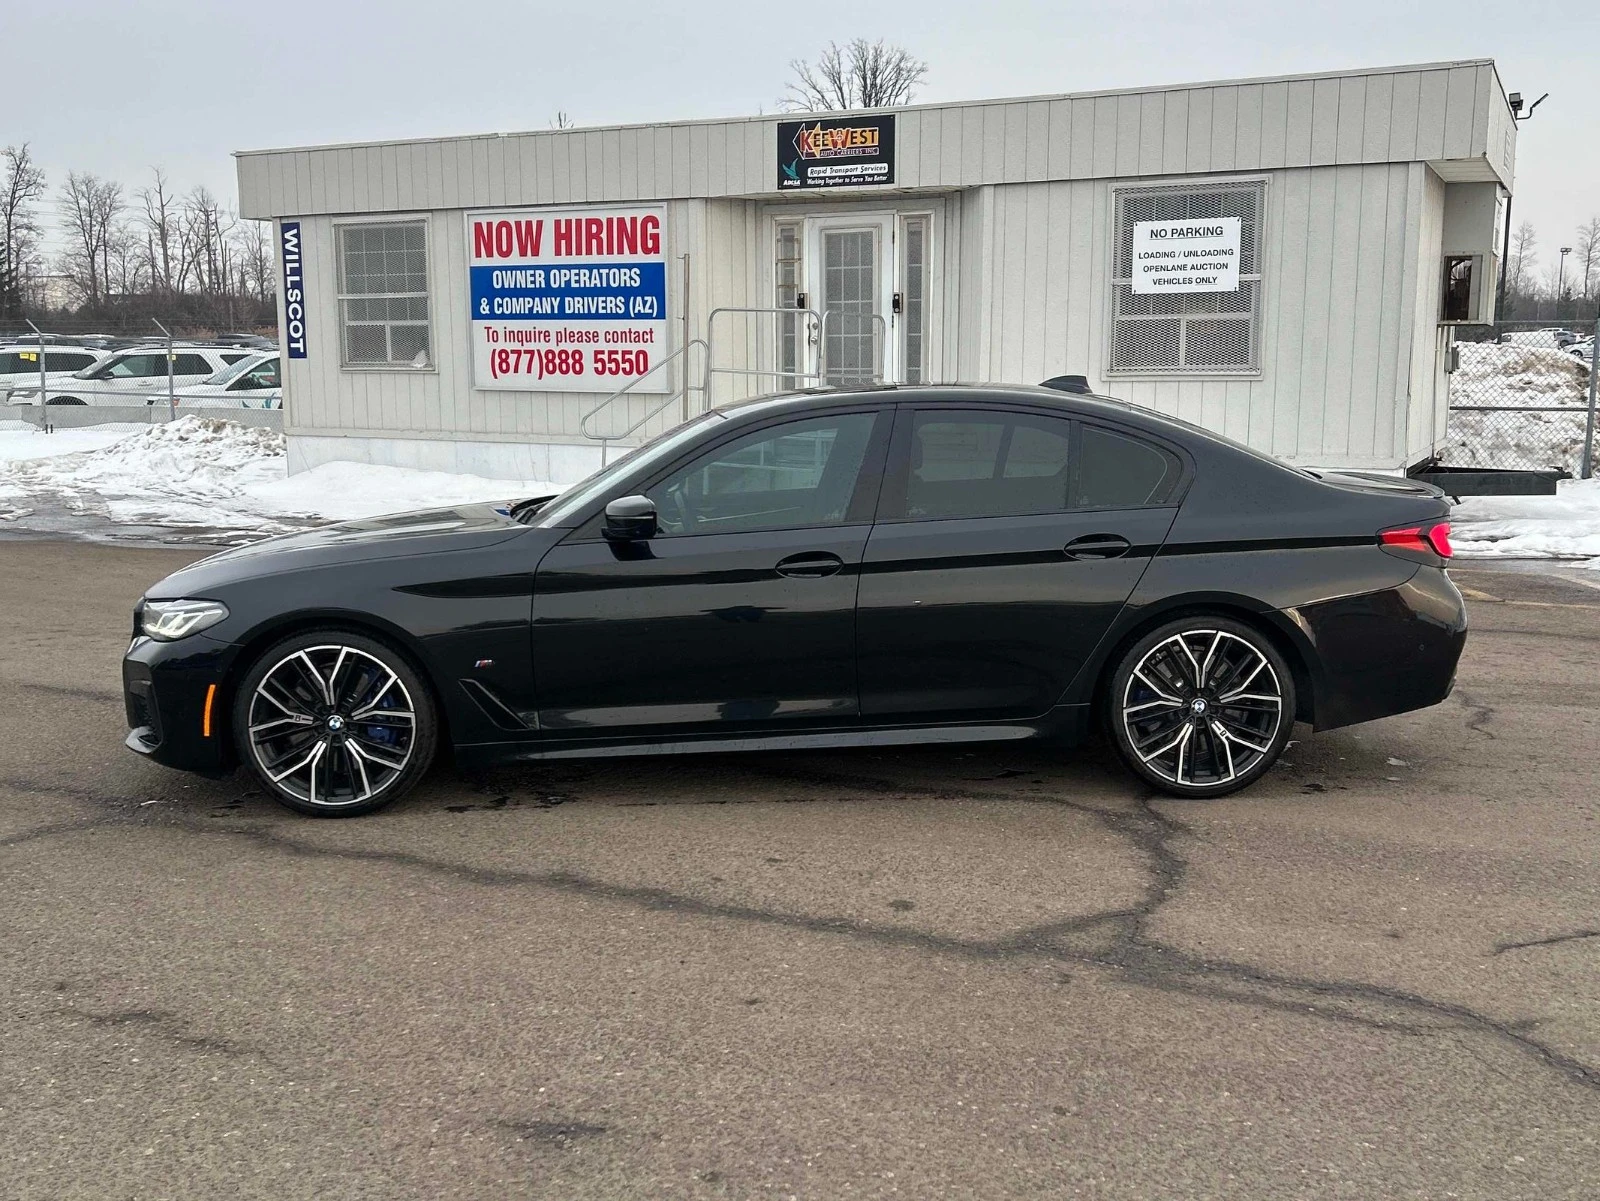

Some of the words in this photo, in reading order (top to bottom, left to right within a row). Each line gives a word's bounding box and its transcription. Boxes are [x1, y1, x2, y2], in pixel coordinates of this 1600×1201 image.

[810, 167, 827, 175] Rapid
[830, 166, 858, 174] Transport
[861, 165, 887, 173] Services
[825, 177, 844, 185] Together
[474, 220, 544, 258] NOW
[554, 215, 660, 256] HIRING
[1150, 229, 1167, 238] NO
[1171, 226, 1223, 237] PARKING
[1139, 251, 1175, 259] LOADING
[1184, 249, 1234, 257] UNLOADING
[1143, 264, 1187, 272] OPENLANE
[1190, 263, 1228, 271] AUCTION
[493, 270, 545, 288] OWNER
[550, 268, 640, 287] OPERATORS
[284, 229, 304, 352] WILLSCOT
[480, 298, 490, 314] &
[494, 297, 560, 314] COMPANY
[565, 297, 625, 313] DRIVERS
[629, 296, 658, 317] (AZ)
[484, 327, 499, 342] To
[504, 327, 551, 346] inquire
[556, 328, 599, 346] please
[604, 328, 654, 343] contact
[490, 349, 584, 379] (877)888
[593, 350, 649, 375] 5550
